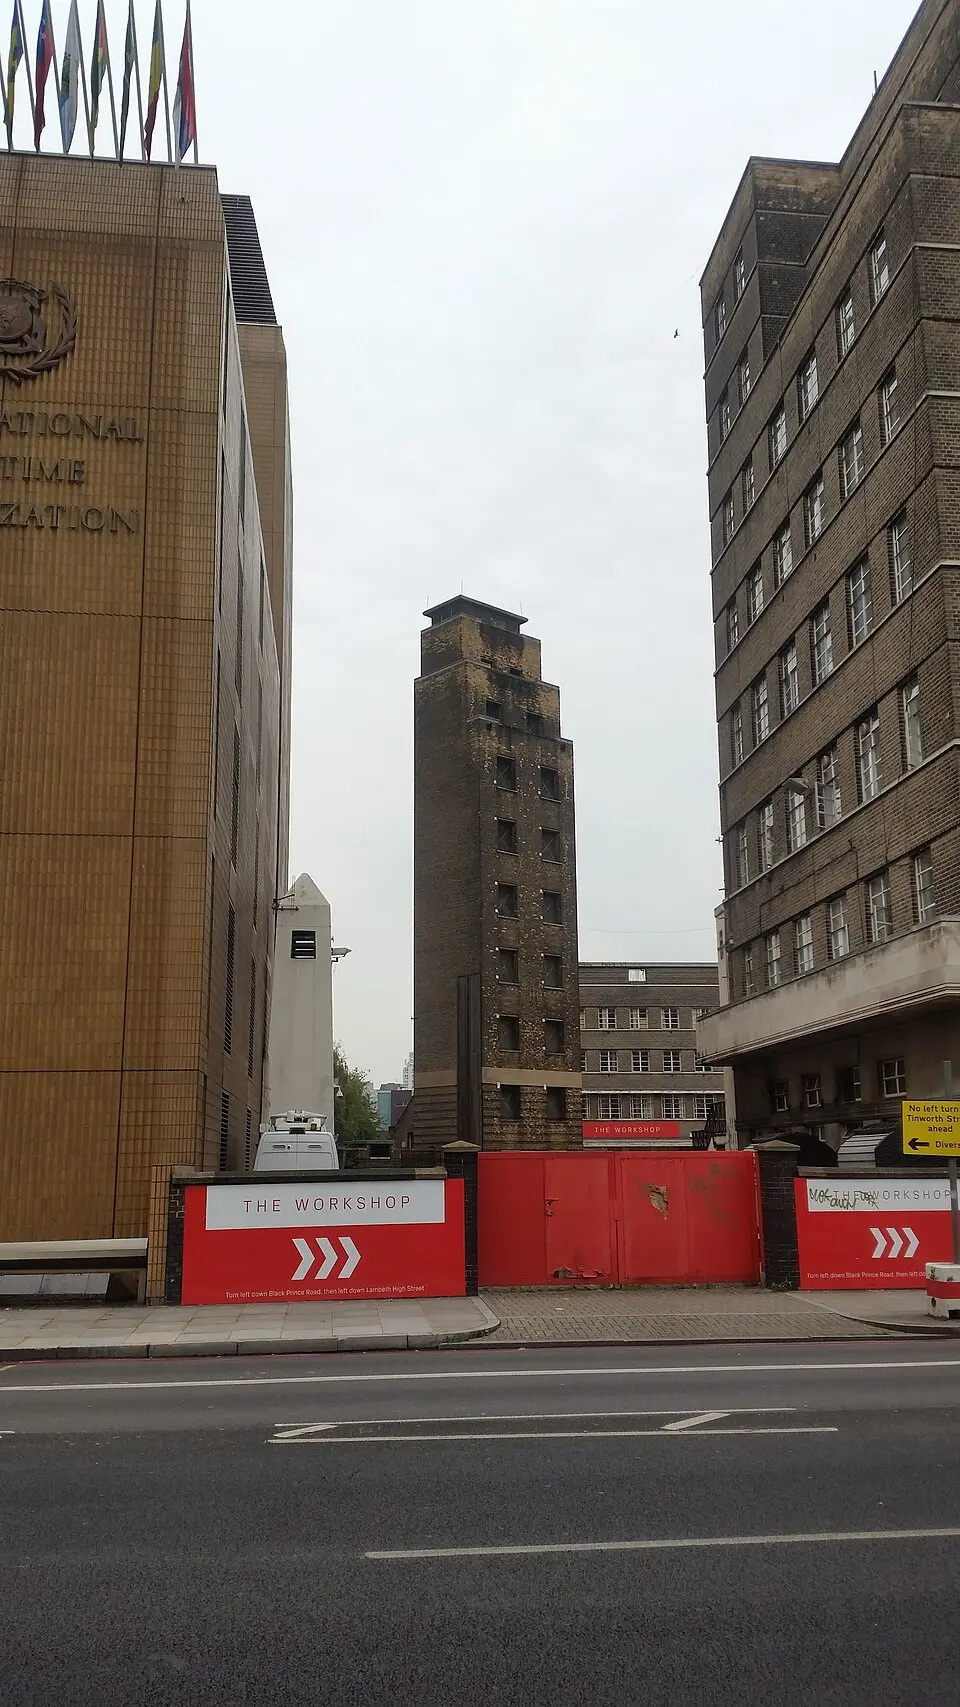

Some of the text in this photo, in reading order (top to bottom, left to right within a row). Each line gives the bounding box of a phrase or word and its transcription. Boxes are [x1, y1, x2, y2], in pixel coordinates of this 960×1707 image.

[0, 411, 144, 441] ATIONAL
[0, 456, 85, 484] TIME
[0, 502, 140, 533] ZATION
[941, 1105, 959, 1113] turn
[907, 1114, 944, 1122] Tinworth
[928, 1125, 953, 1133] ahead
[833, 1190, 860, 1200] THE
[869, 1190, 951, 1200] WORKSHOP
[243, 1195, 411, 1213] THE WORKSHOP
[323, 1287, 337, 1295] then
[348, 1286, 365, 1294] down
[366, 1285, 391, 1293] Lambeth
[392, 1285, 406, 1293] High
[406, 1284, 425, 1292] Street
